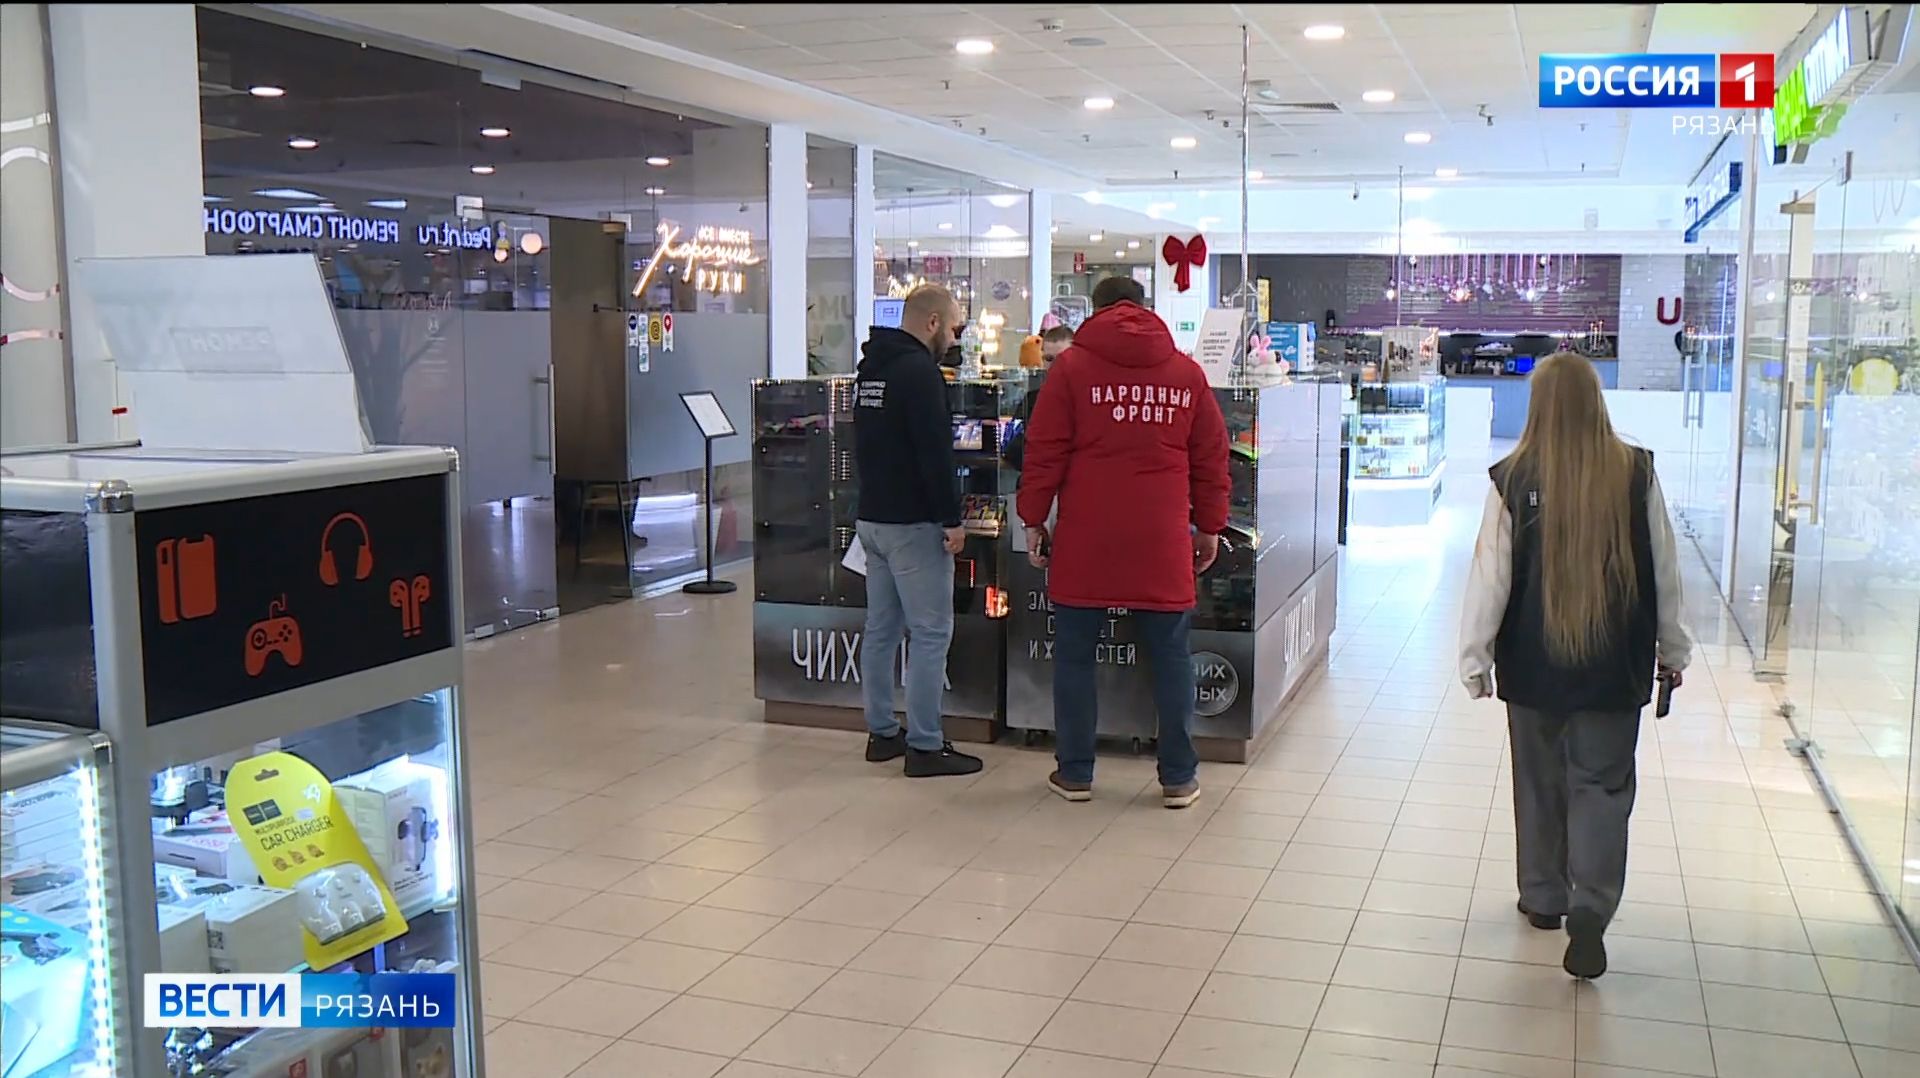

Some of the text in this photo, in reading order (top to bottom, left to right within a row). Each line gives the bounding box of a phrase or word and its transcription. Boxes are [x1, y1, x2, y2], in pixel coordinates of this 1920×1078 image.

[695, 267, 746, 294] РУКИ
[1091, 384, 1192, 409] НАРОДНЫЙ
[1112, 403, 1176, 425] ФРОНТ
[792, 627, 861, 684] ЧИХ
[1043, 639, 1137, 666] ЖСТЕЙ
[259, 815, 335, 852] CAR CHARGER
